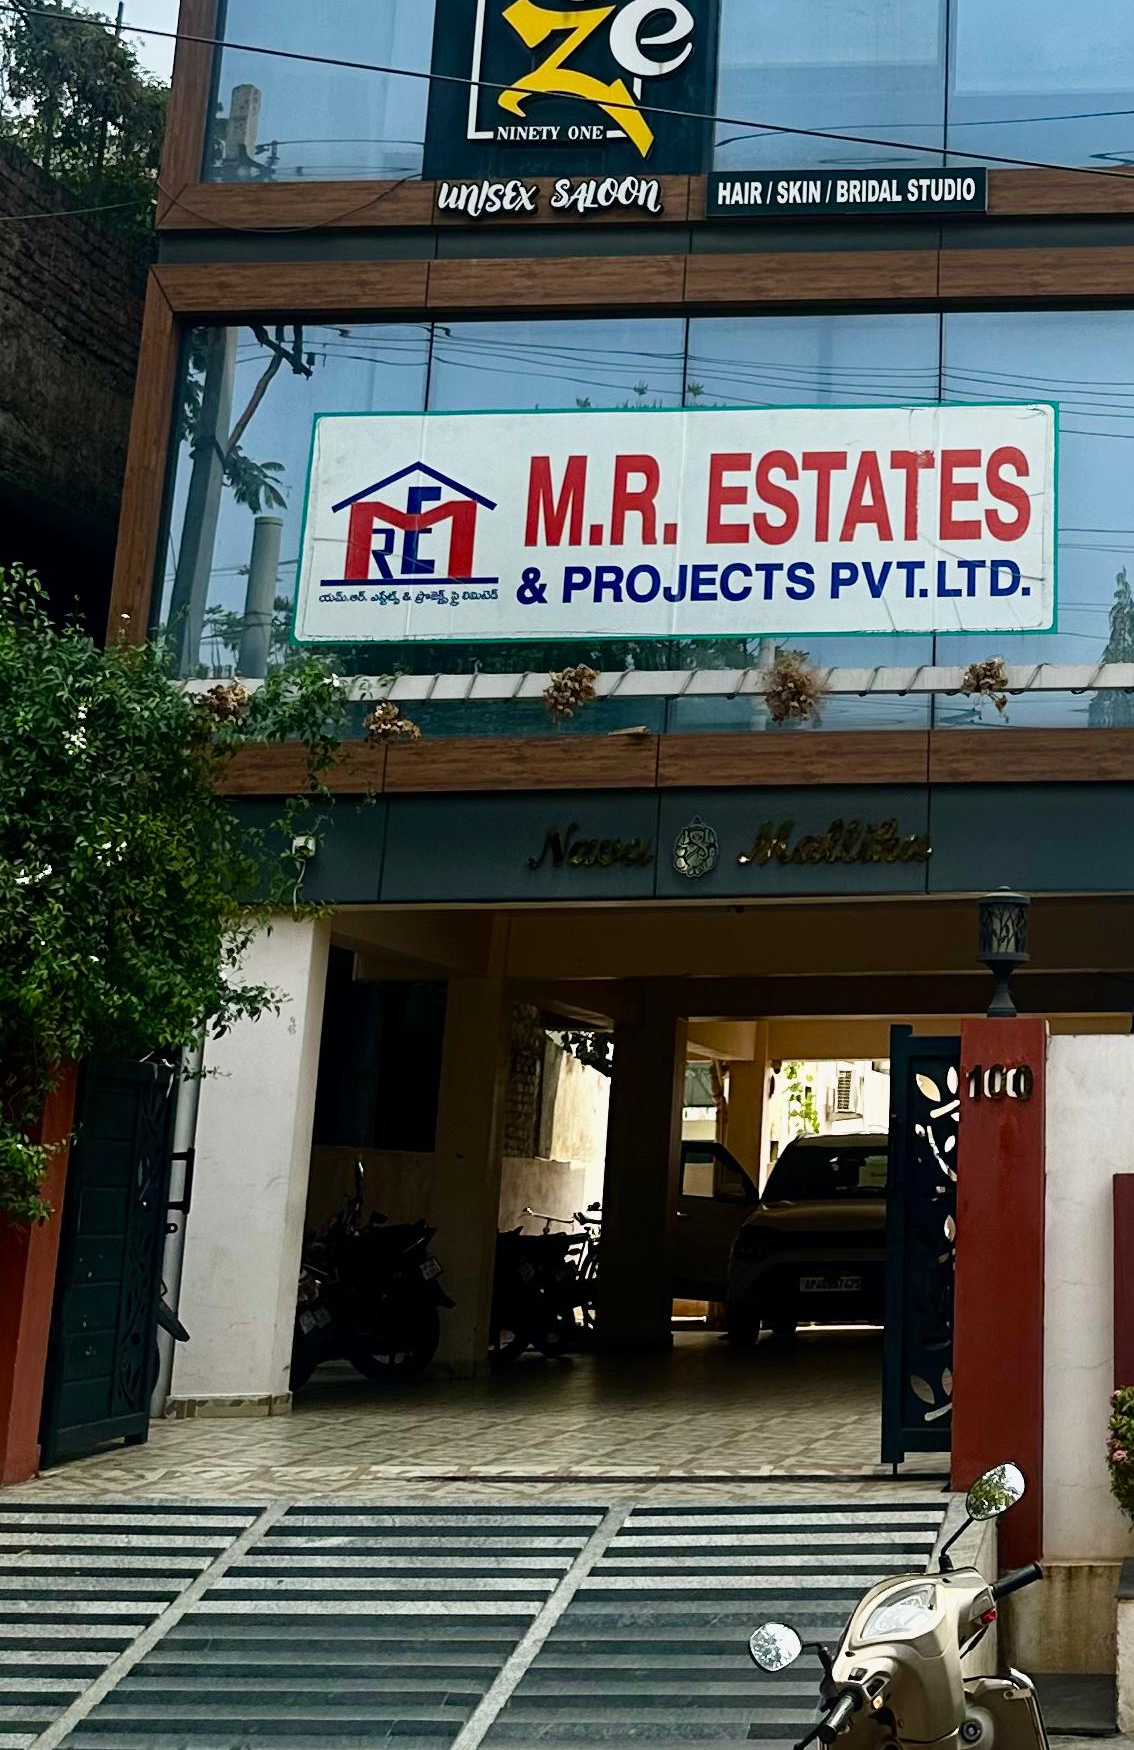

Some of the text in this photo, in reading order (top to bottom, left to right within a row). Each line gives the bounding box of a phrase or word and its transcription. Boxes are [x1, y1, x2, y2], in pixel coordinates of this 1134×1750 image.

[496, 125, 605, 140] NINETY ONE
[718, 181, 762, 205] HAIR
[777, 180, 821, 204] SKIN
[836, 179, 902, 203] BRIDAL
[907, 178, 976, 202] STUDIO
[524, 446, 1031, 547] M.R. ESTATES
[516, 567, 548, 605] &
[562, 561, 815, 605] PROJECTS
[965, 1064, 1033, 1100] 100
